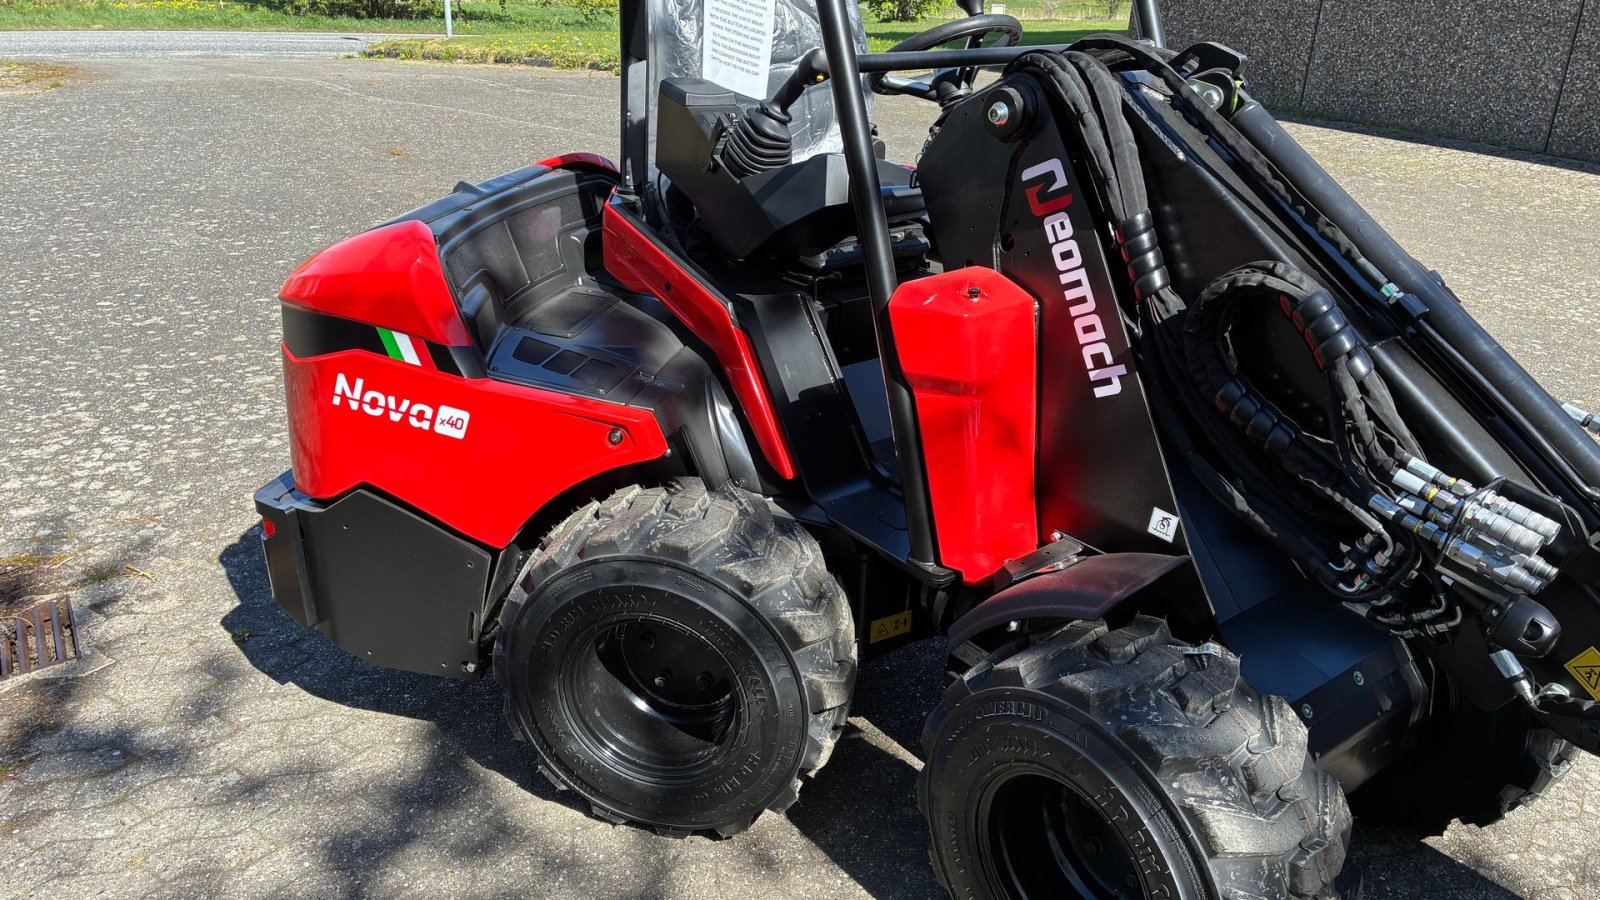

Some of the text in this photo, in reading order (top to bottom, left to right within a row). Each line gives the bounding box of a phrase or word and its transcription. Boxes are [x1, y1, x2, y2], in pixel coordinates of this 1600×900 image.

[742, 42, 760, 52] MACHINE
[1022, 158, 1127, 398] Neomach
[332, 372, 464, 431] Nova x40
